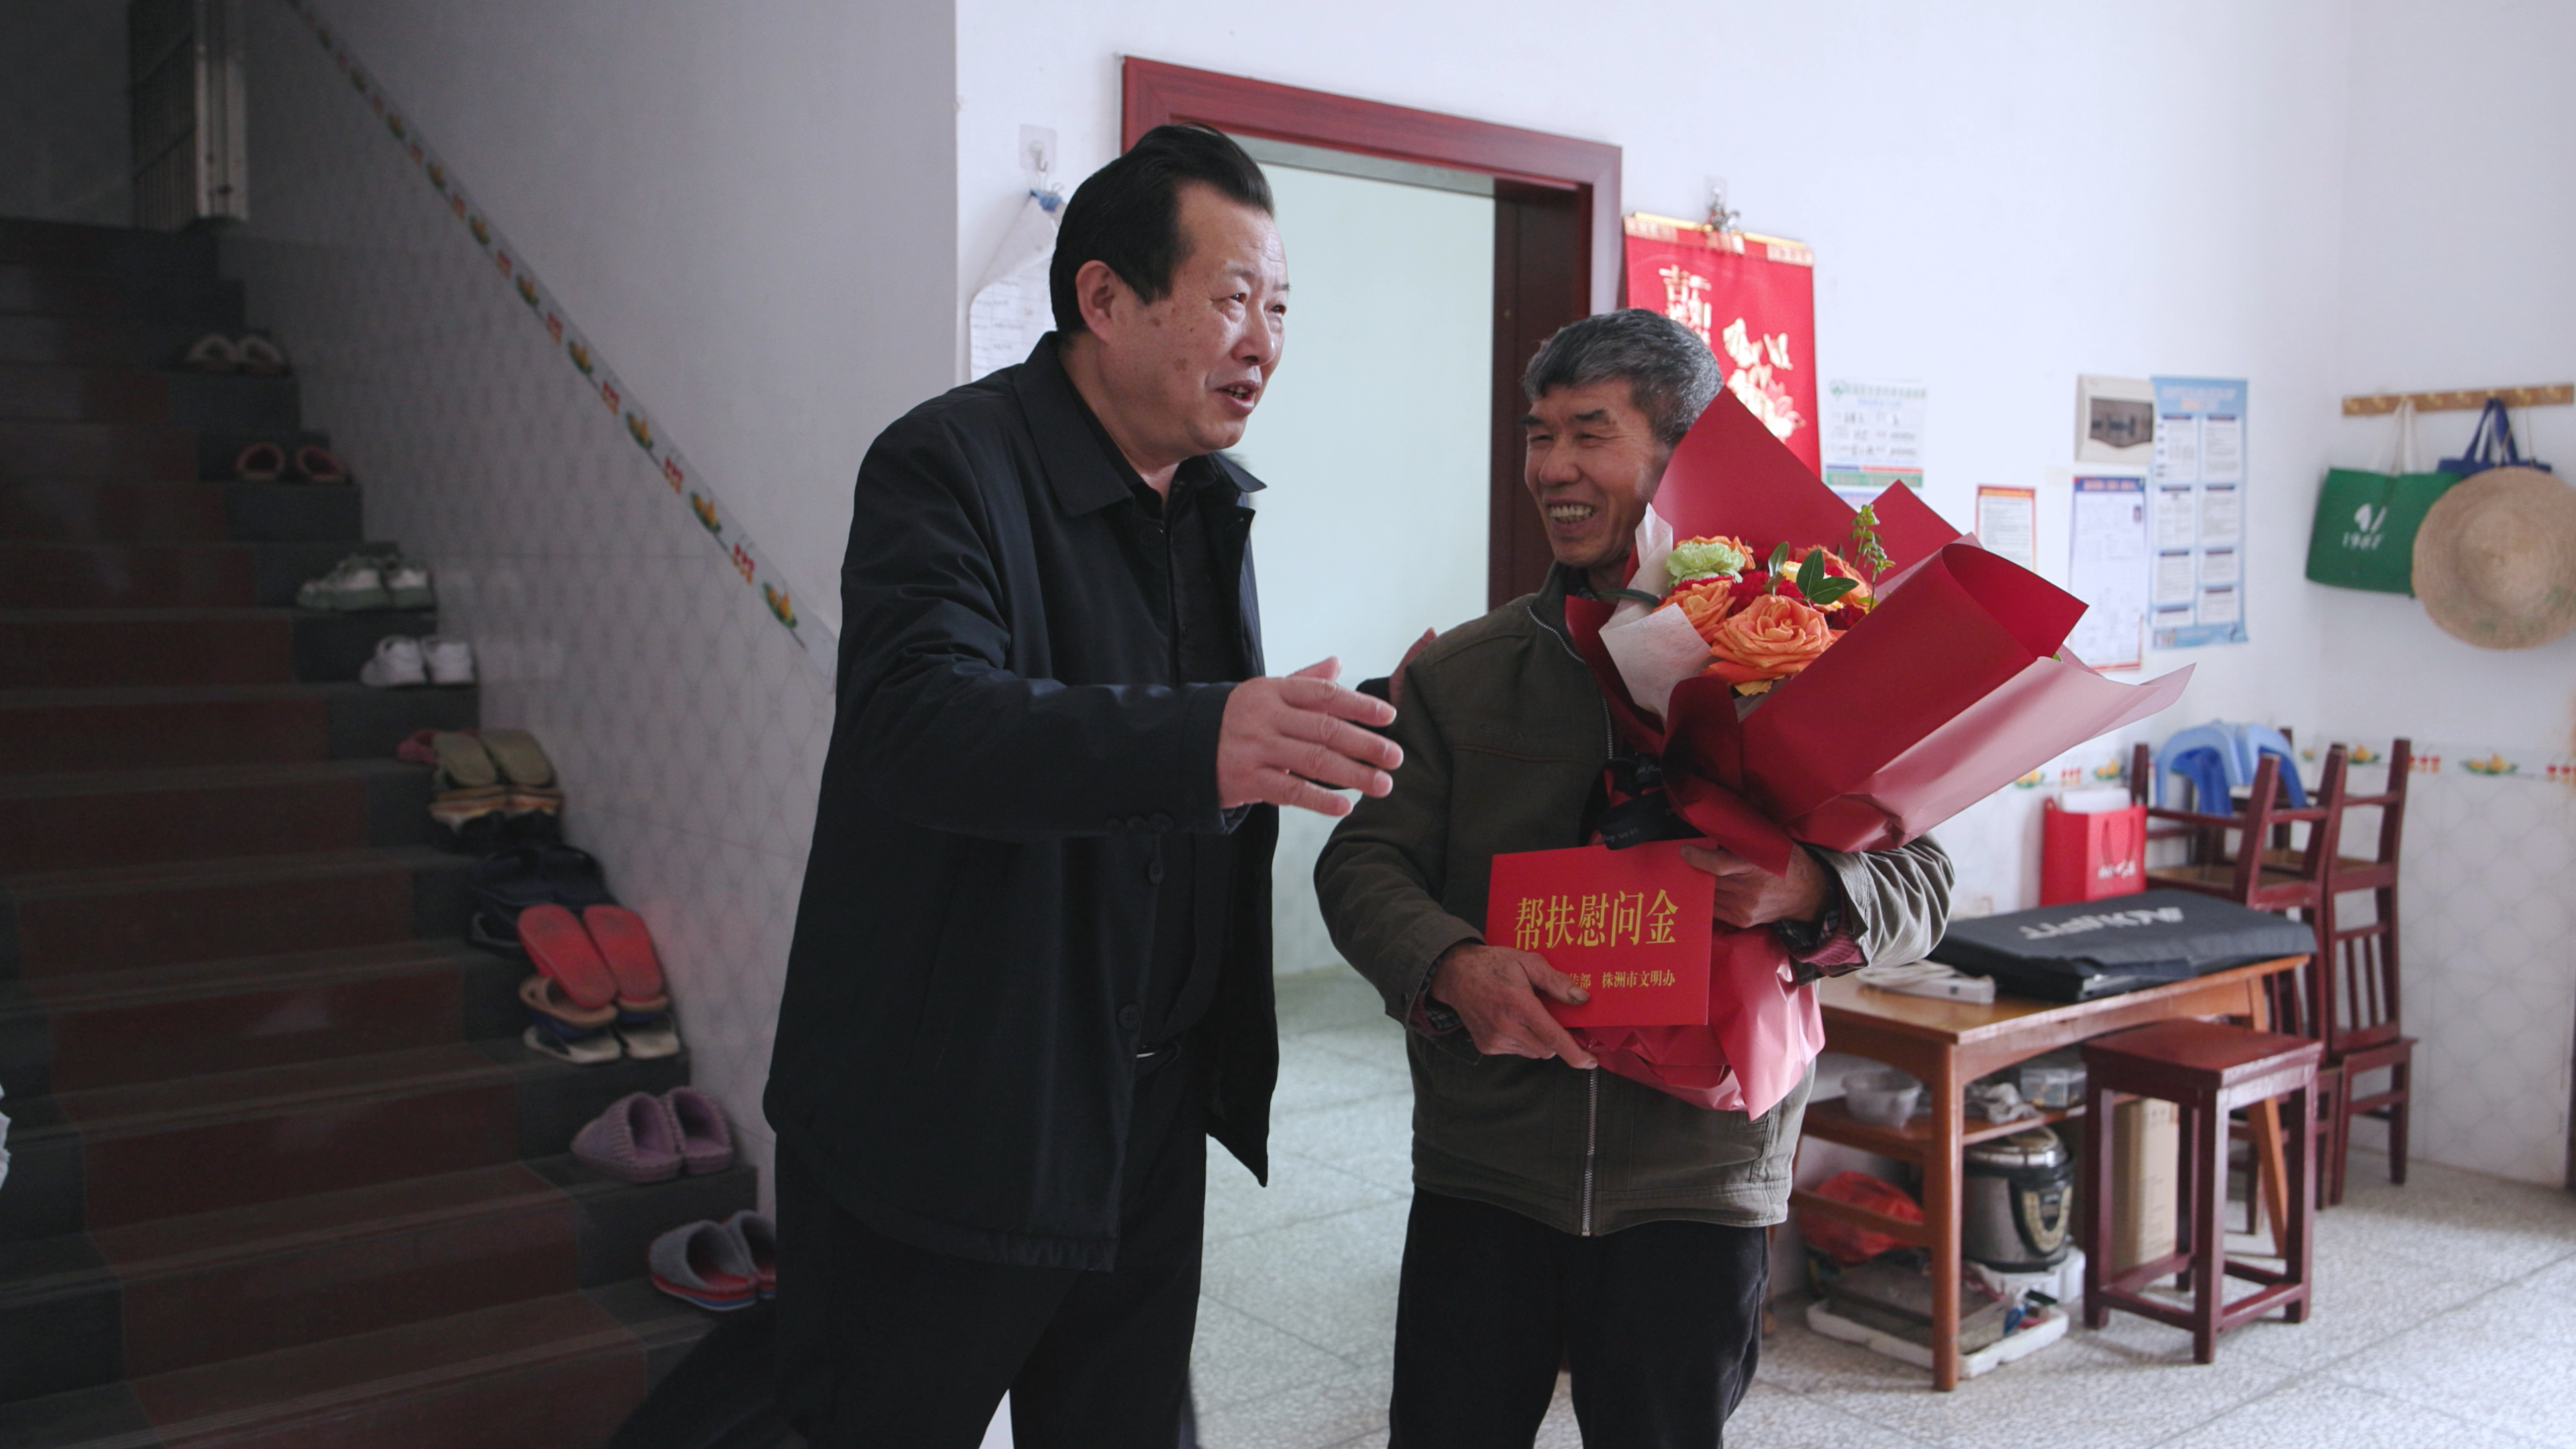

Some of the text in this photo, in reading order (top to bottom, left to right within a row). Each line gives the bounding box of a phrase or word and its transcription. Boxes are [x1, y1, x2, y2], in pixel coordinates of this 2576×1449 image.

[1514, 889, 1678, 951] 帮扶慰问金
[1602, 969, 1675, 989] 株洲市文明办
